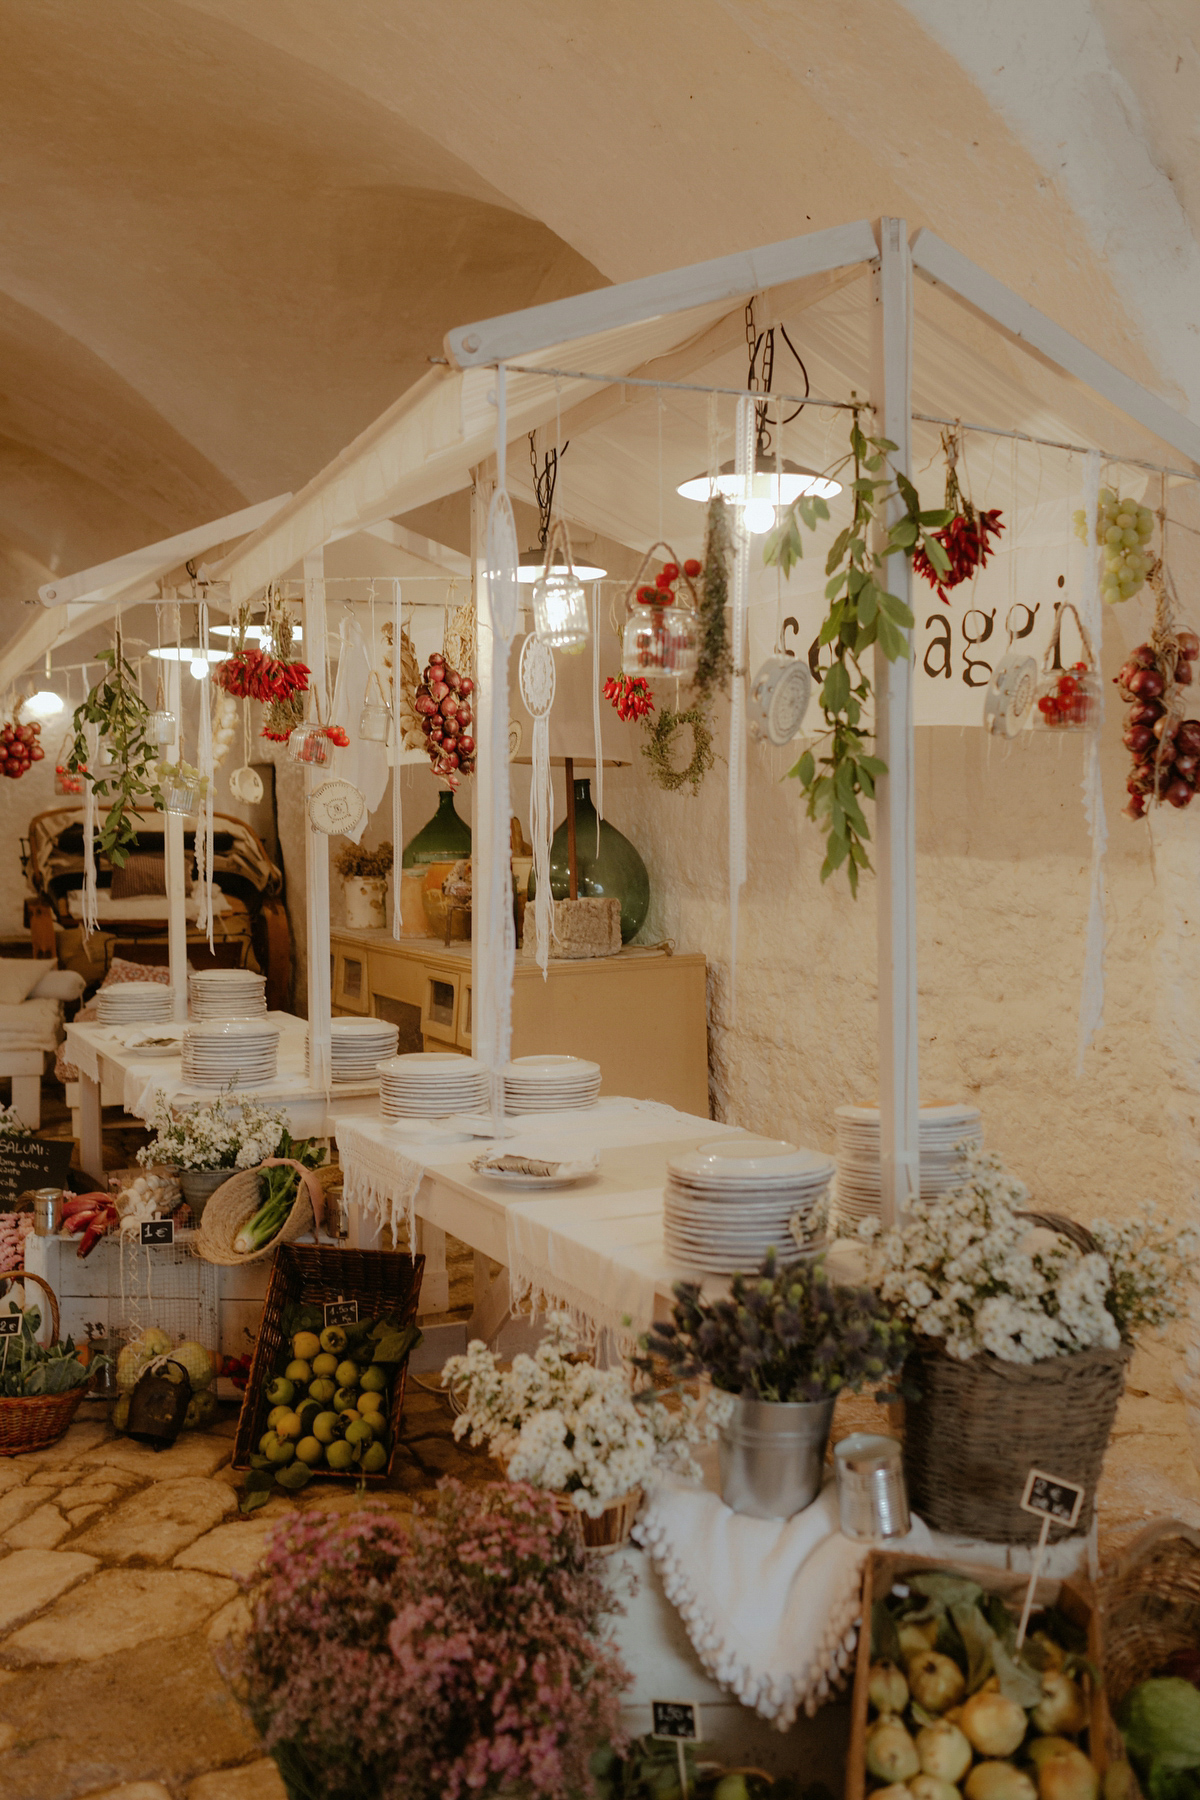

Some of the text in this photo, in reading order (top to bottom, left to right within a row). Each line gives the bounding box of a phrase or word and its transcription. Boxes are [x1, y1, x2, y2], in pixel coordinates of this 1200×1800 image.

[144, 1224, 168, 1238] 1 €
[0, 1320, 7, 1331] 2
